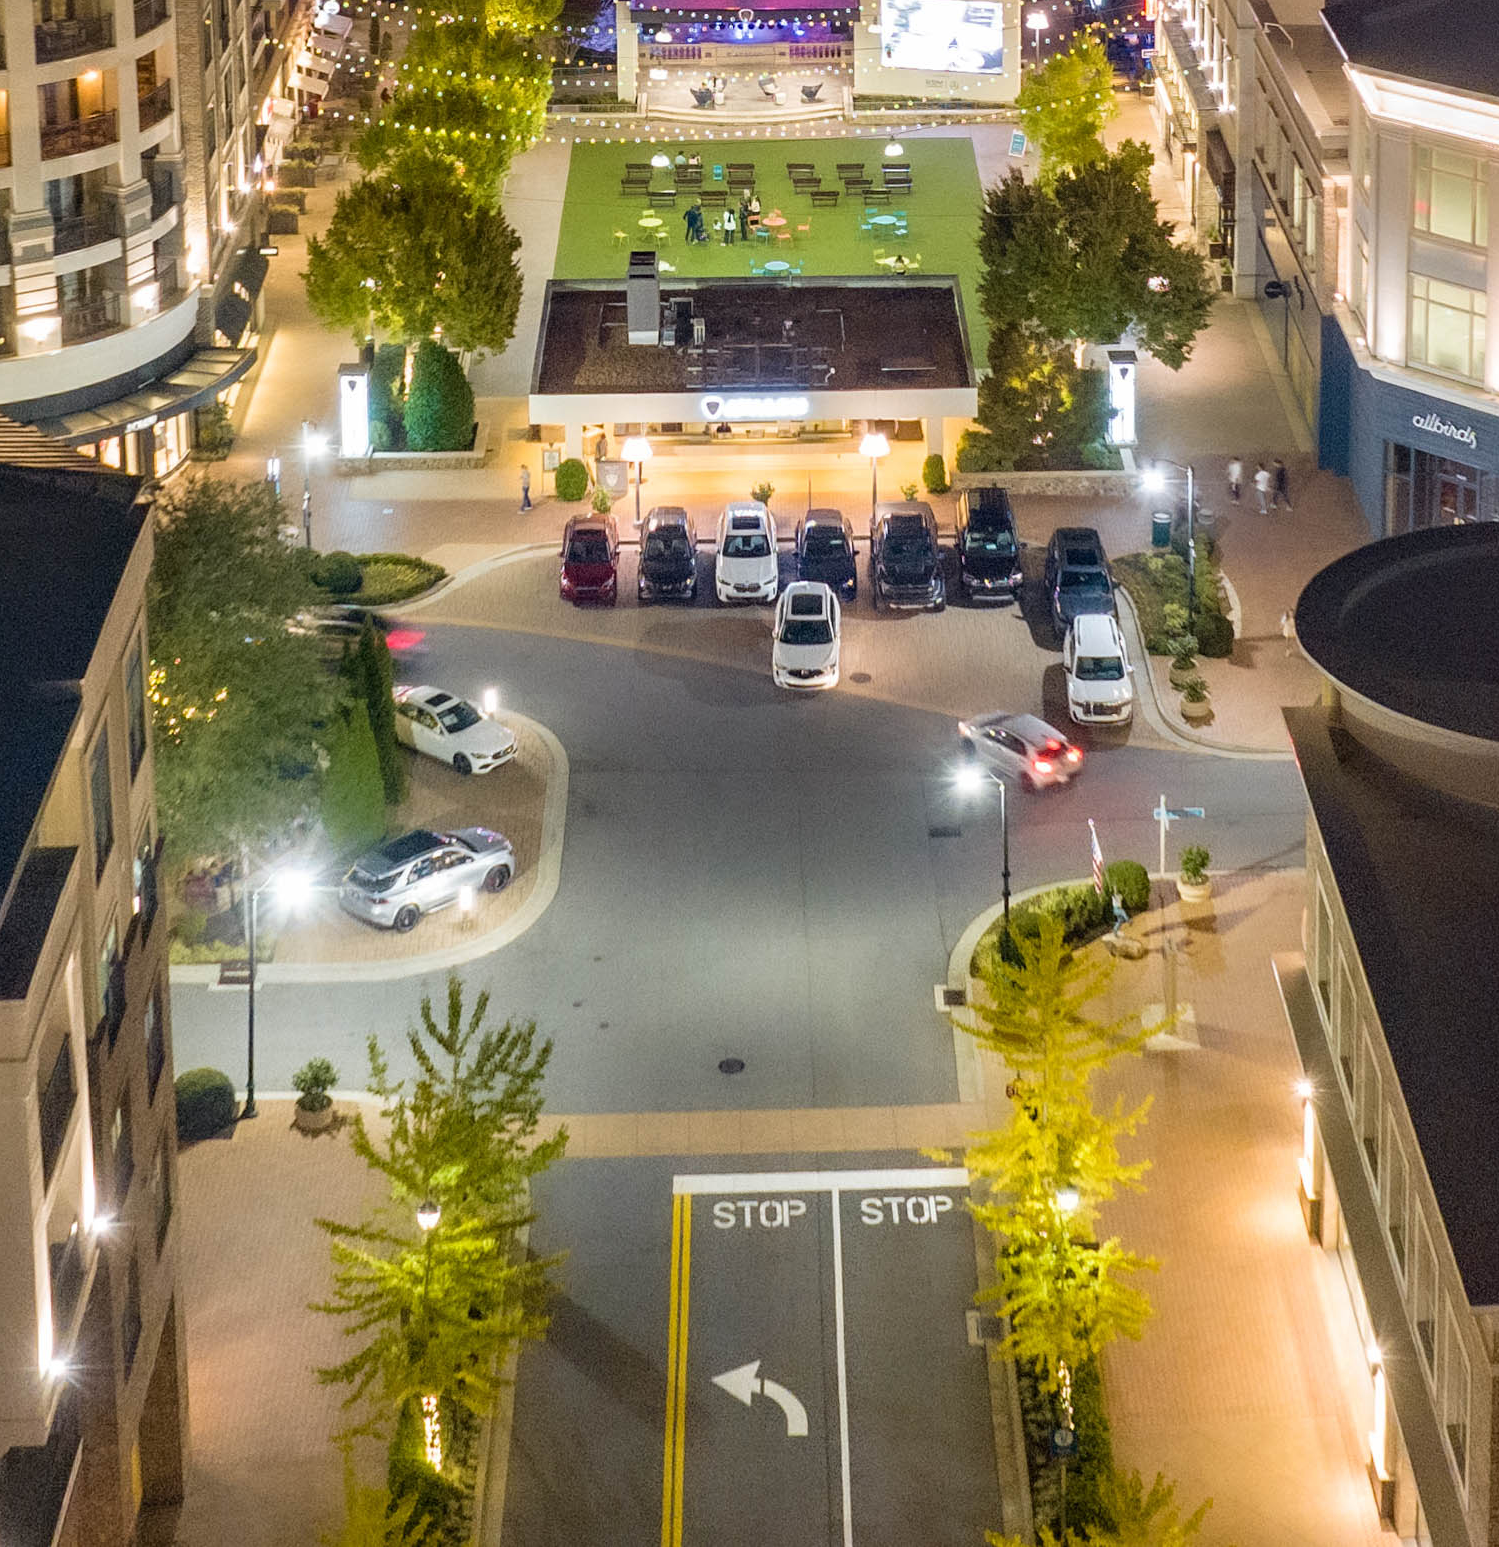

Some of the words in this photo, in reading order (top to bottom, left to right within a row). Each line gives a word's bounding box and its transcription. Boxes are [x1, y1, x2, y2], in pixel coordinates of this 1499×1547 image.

[1412, 414, 1477, 449] allbirds
[713, 1199, 807, 1229] STOP
[860, 1195, 954, 1225] STOP
